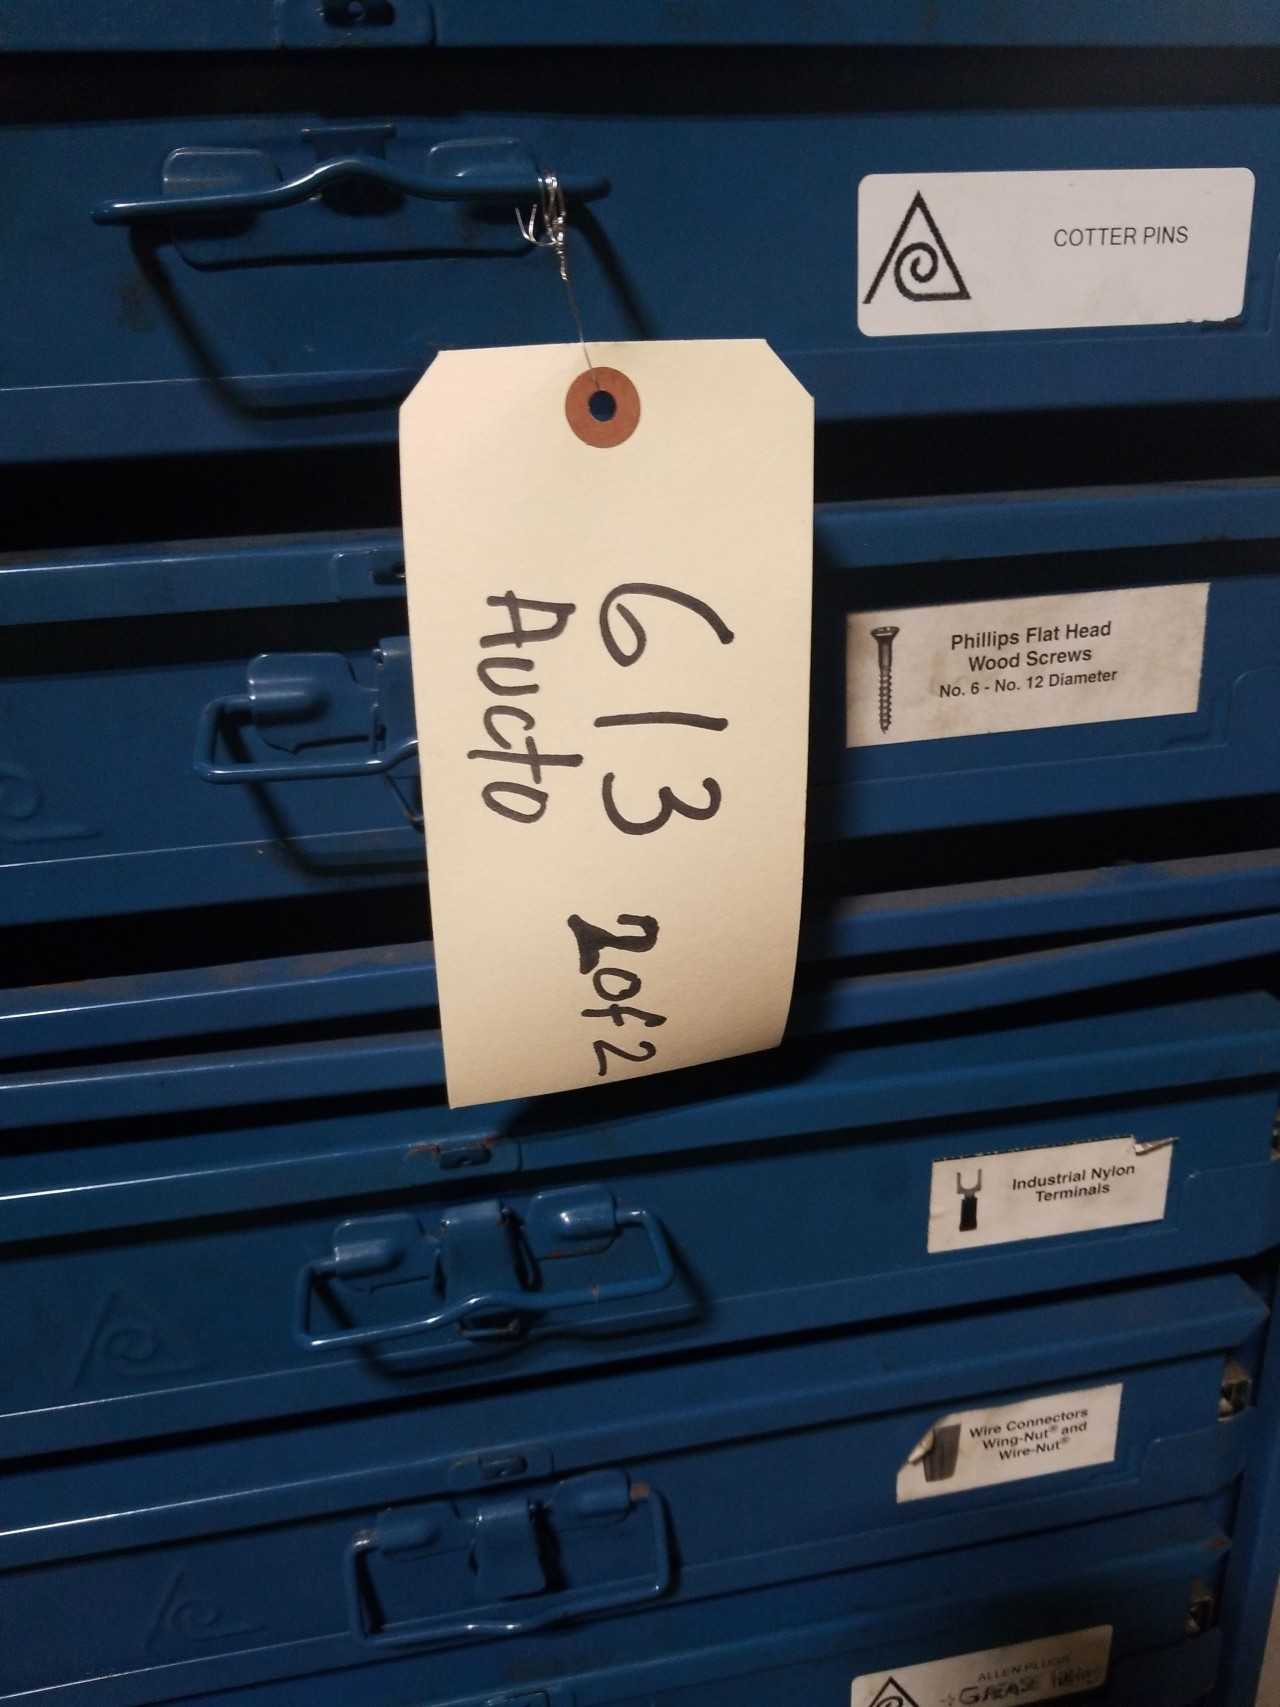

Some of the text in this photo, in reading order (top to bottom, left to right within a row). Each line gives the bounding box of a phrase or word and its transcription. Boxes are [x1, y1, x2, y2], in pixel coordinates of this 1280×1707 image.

[1053, 226, 1188, 247] COTTER PINS
[951, 621, 1112, 651] Phillips Flat Head
[969, 649, 1092, 673] Wood Screws
[939, 684, 965, 698] No.
[970, 682, 980, 694] 6
[995, 678, 1020, 693] No.
[1026, 676, 1044, 689] 12
[1049, 669, 1117, 686] Diameter
[467, 589, 583, 824] Aucto
[594, 581, 734, 835] 613
[1012, 1165, 1135, 1190] Industrial Nylon
[1036, 1183, 1110, 1202] Terminals
[970, 1408, 1088, 1438] Wire Connectors
[1061, 1421, 1087, 1434] and
